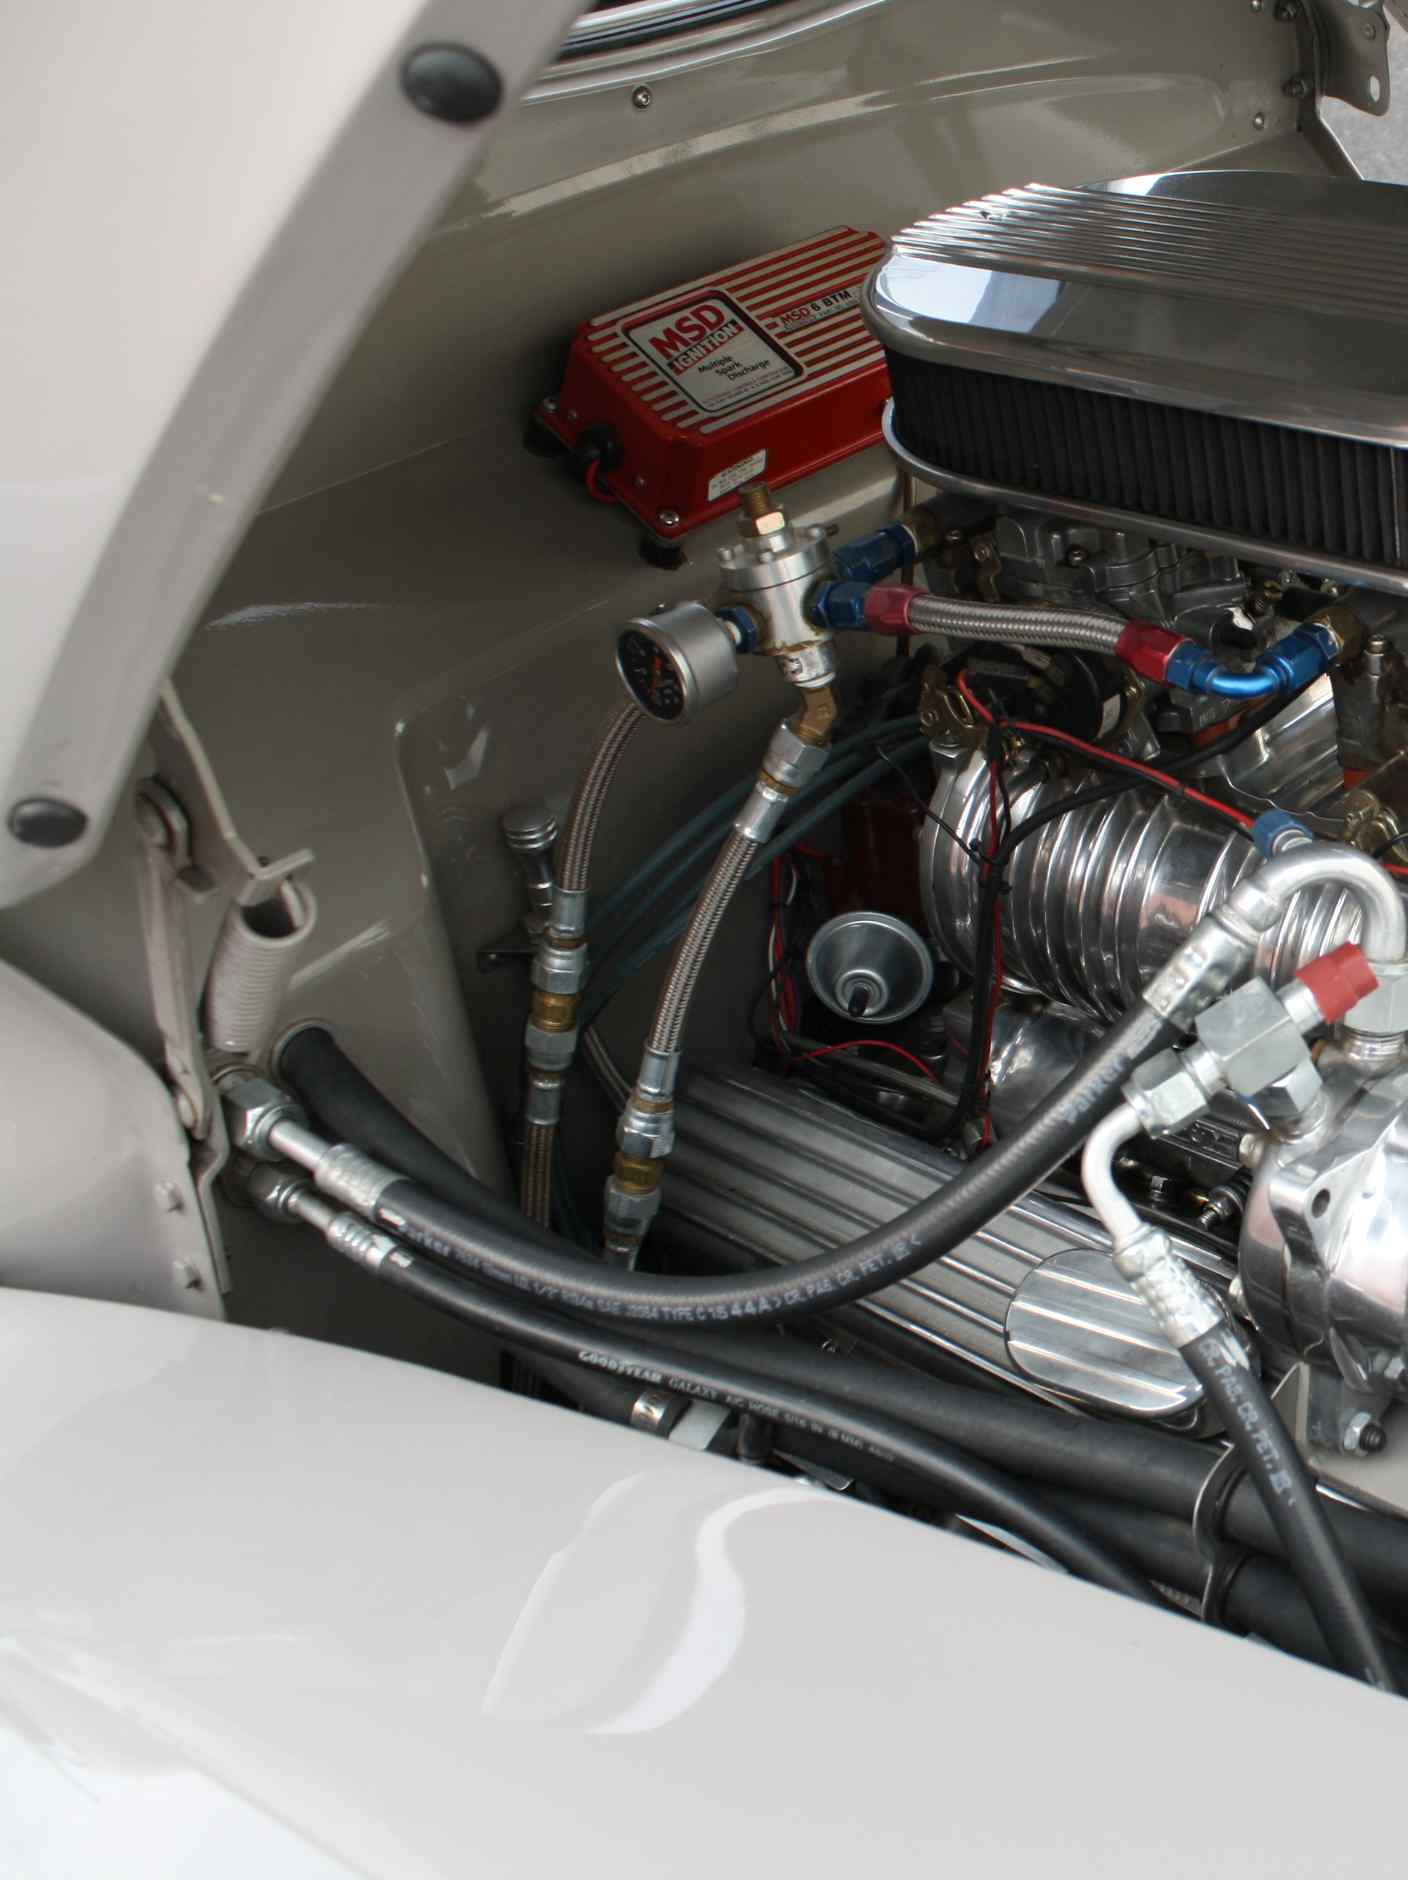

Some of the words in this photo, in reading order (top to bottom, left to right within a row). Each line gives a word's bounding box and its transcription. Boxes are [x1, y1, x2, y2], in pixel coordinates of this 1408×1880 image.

[781, 307, 810, 325] MSD
[810, 302, 821, 312] 6
[649, 304, 725, 361] MSD
[672, 322, 740, 372] IGNITION
[698, 354, 733, 373] Multiple
[715, 361, 742, 376] Spark
[727, 359, 771, 381] Discharge
[660, 1306, 694, 1321] TYPE
